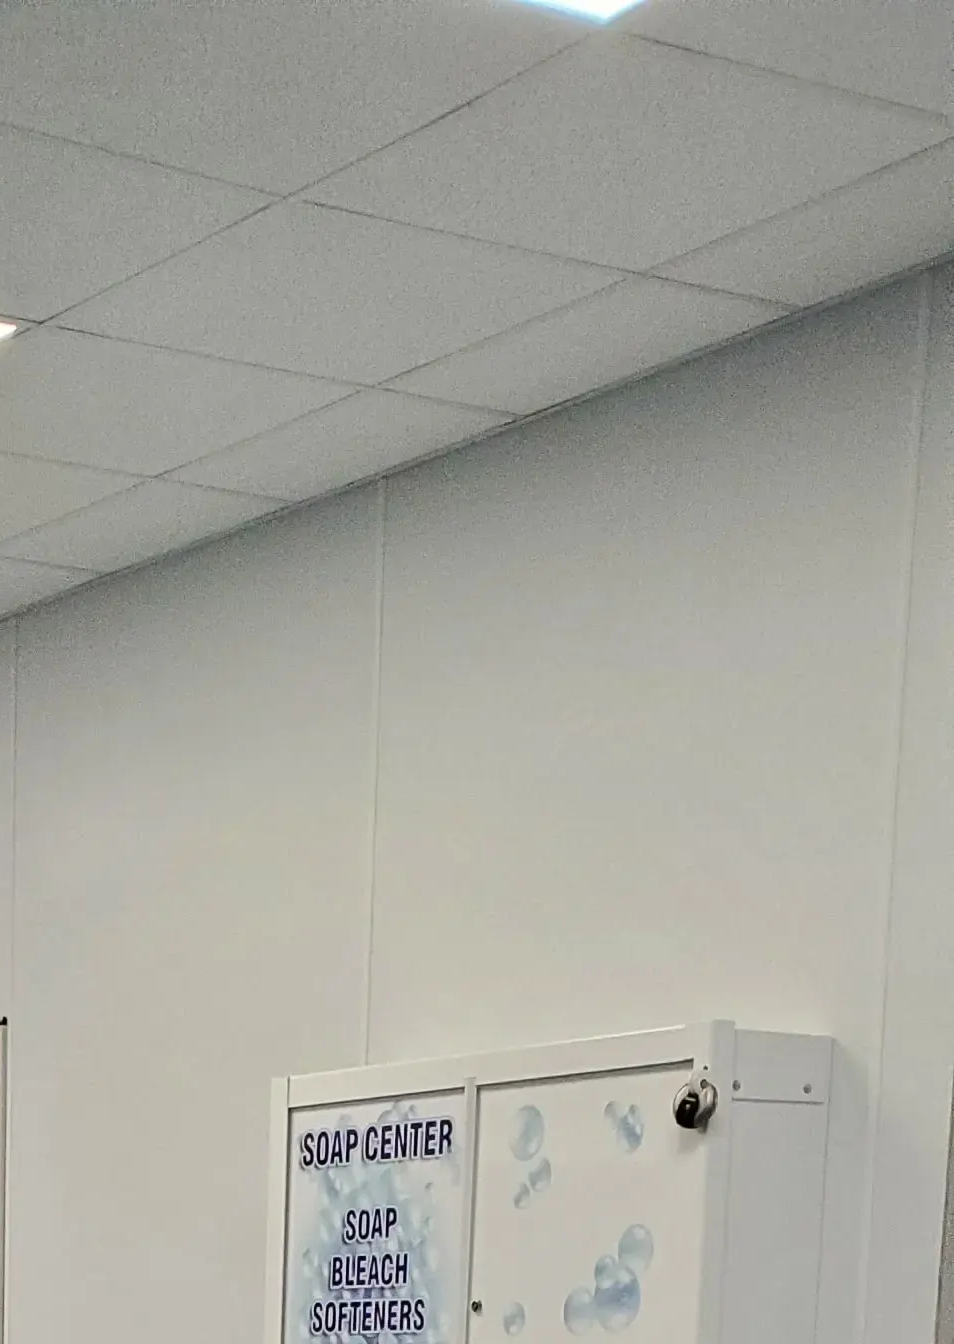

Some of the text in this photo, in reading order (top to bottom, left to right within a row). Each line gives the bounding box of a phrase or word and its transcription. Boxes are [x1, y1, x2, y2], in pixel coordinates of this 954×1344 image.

[302, 1119, 453, 1167] SOAP CENTER
[345, 1207, 397, 1241] SOAP
[331, 1253, 408, 1287] BLEACH
[312, 1299, 425, 1333] SOFTENERS
